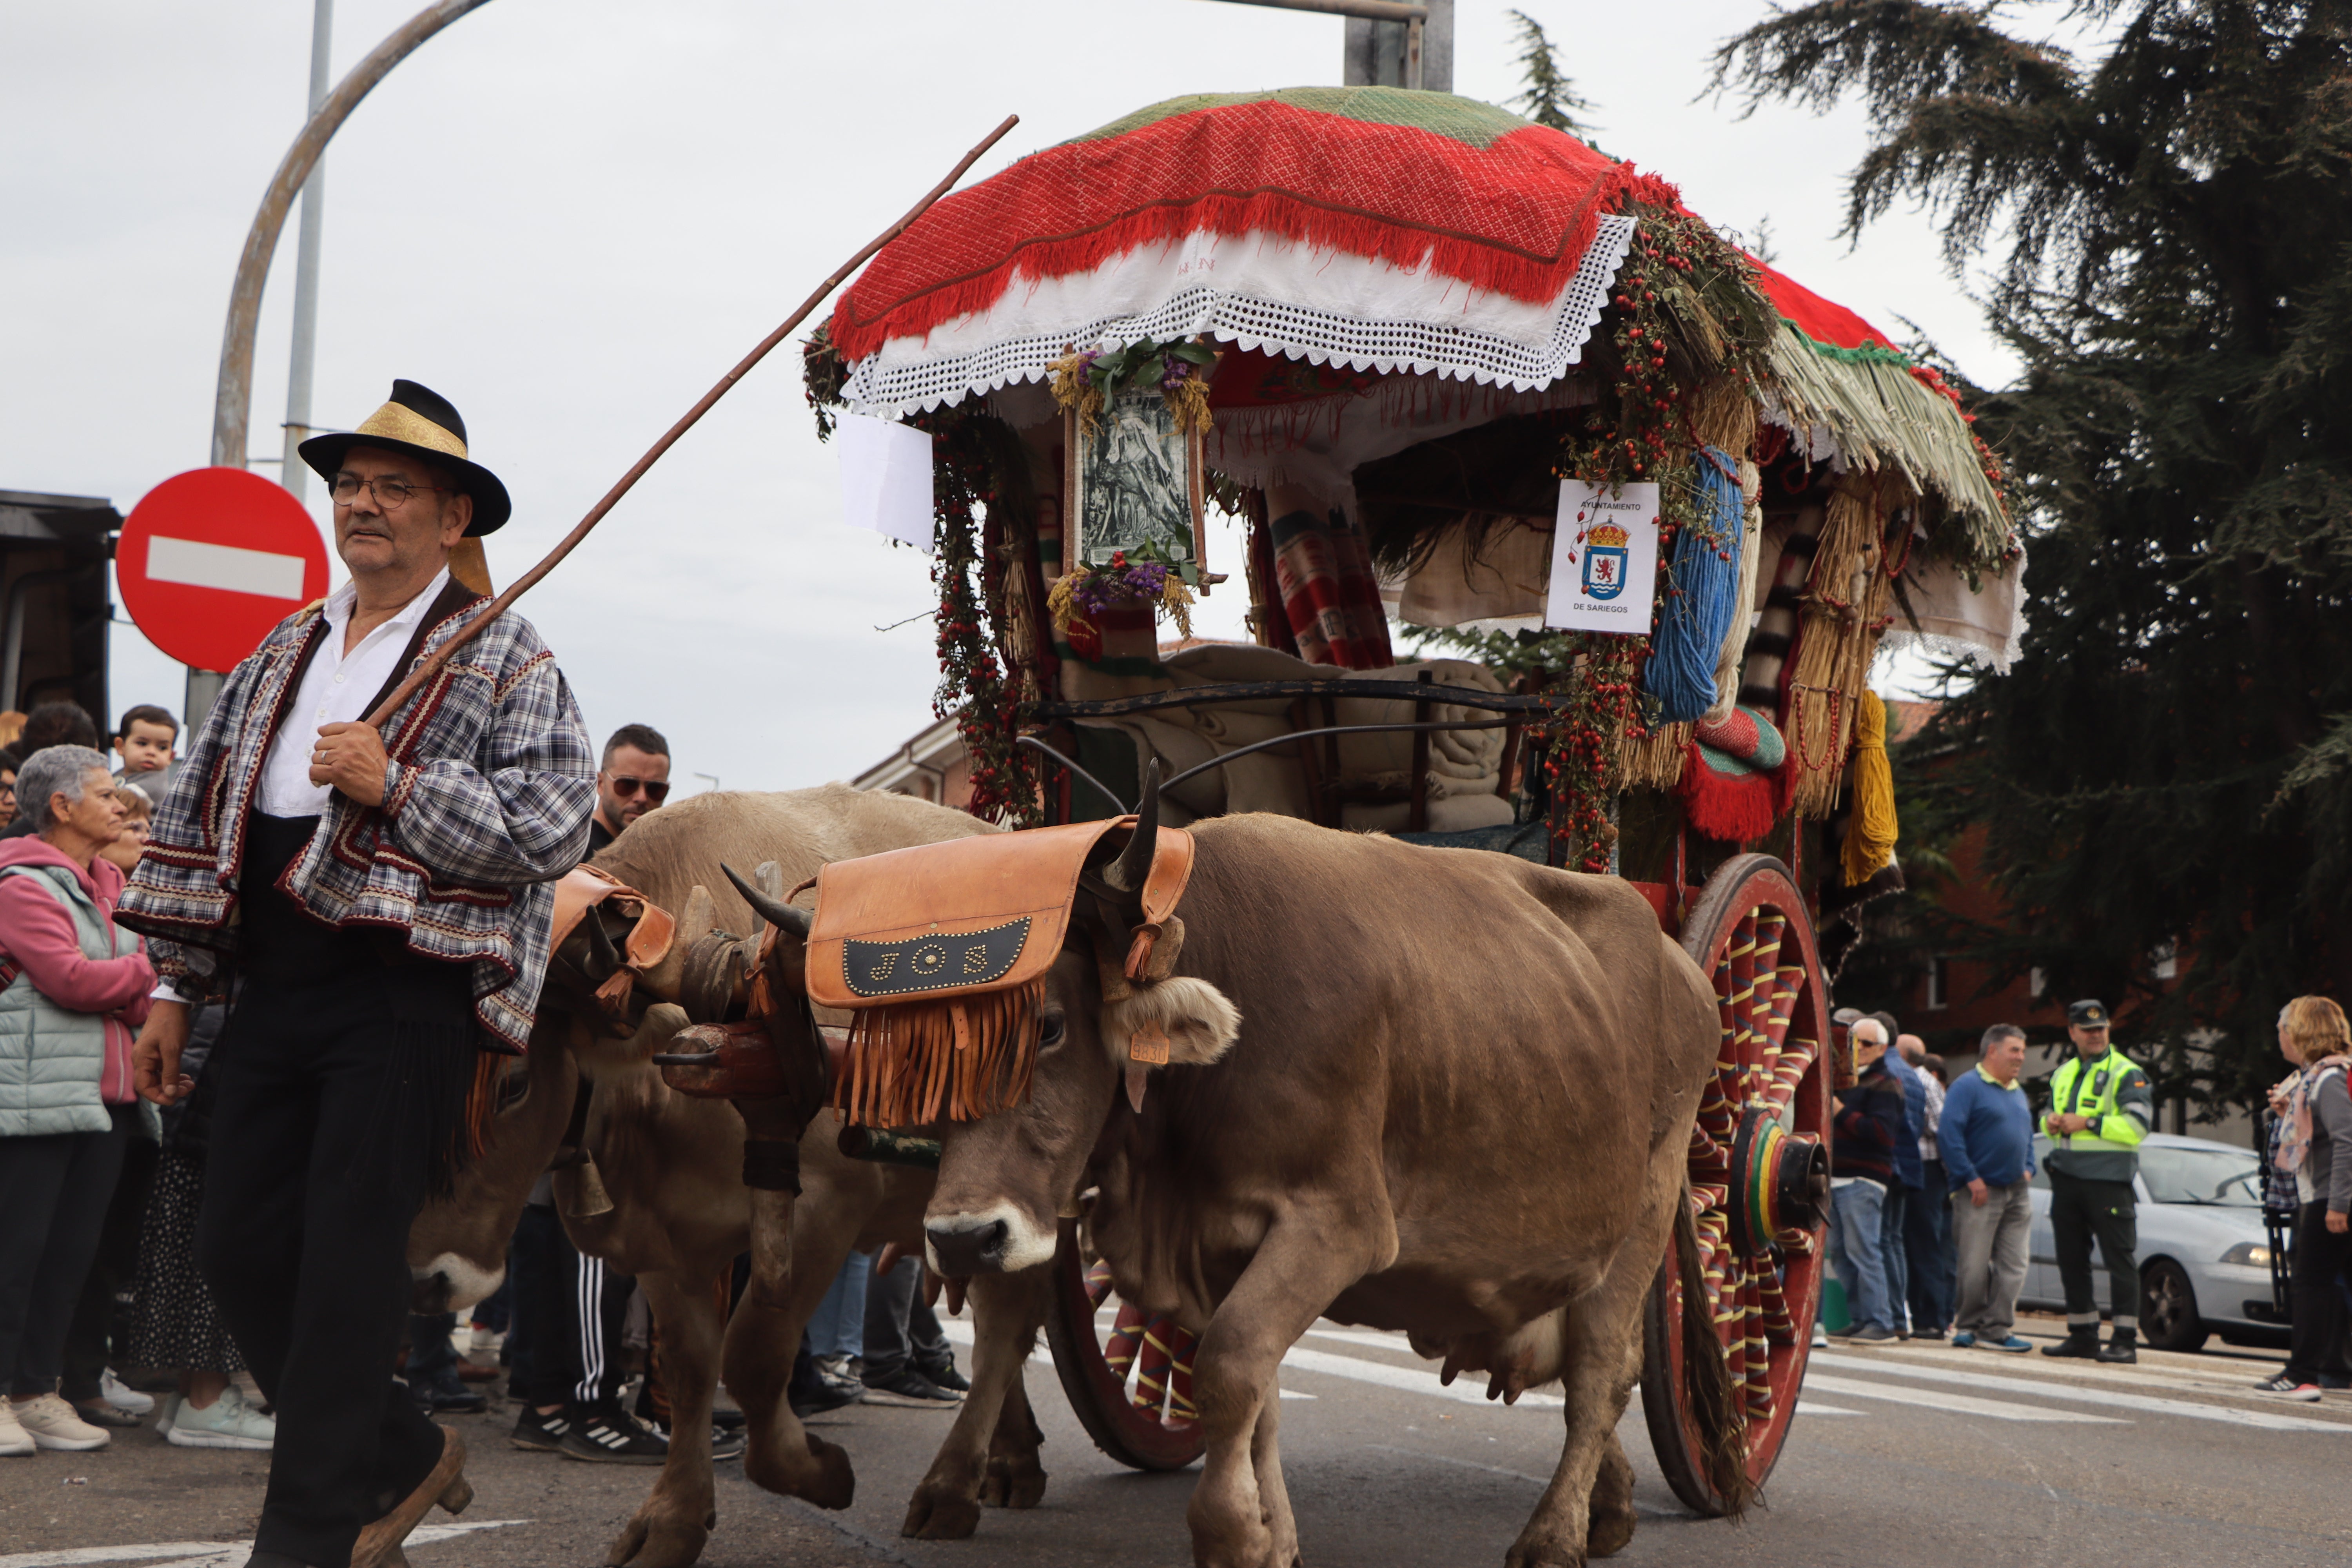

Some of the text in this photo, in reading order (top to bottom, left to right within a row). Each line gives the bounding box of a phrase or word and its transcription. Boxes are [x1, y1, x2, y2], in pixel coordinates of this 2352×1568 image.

[1581, 501, 1641, 510] AYUNTAMIENTO
[1587, 604, 1628, 613] SARIEGOS
[1132, 1044, 1166, 1062] 9830
